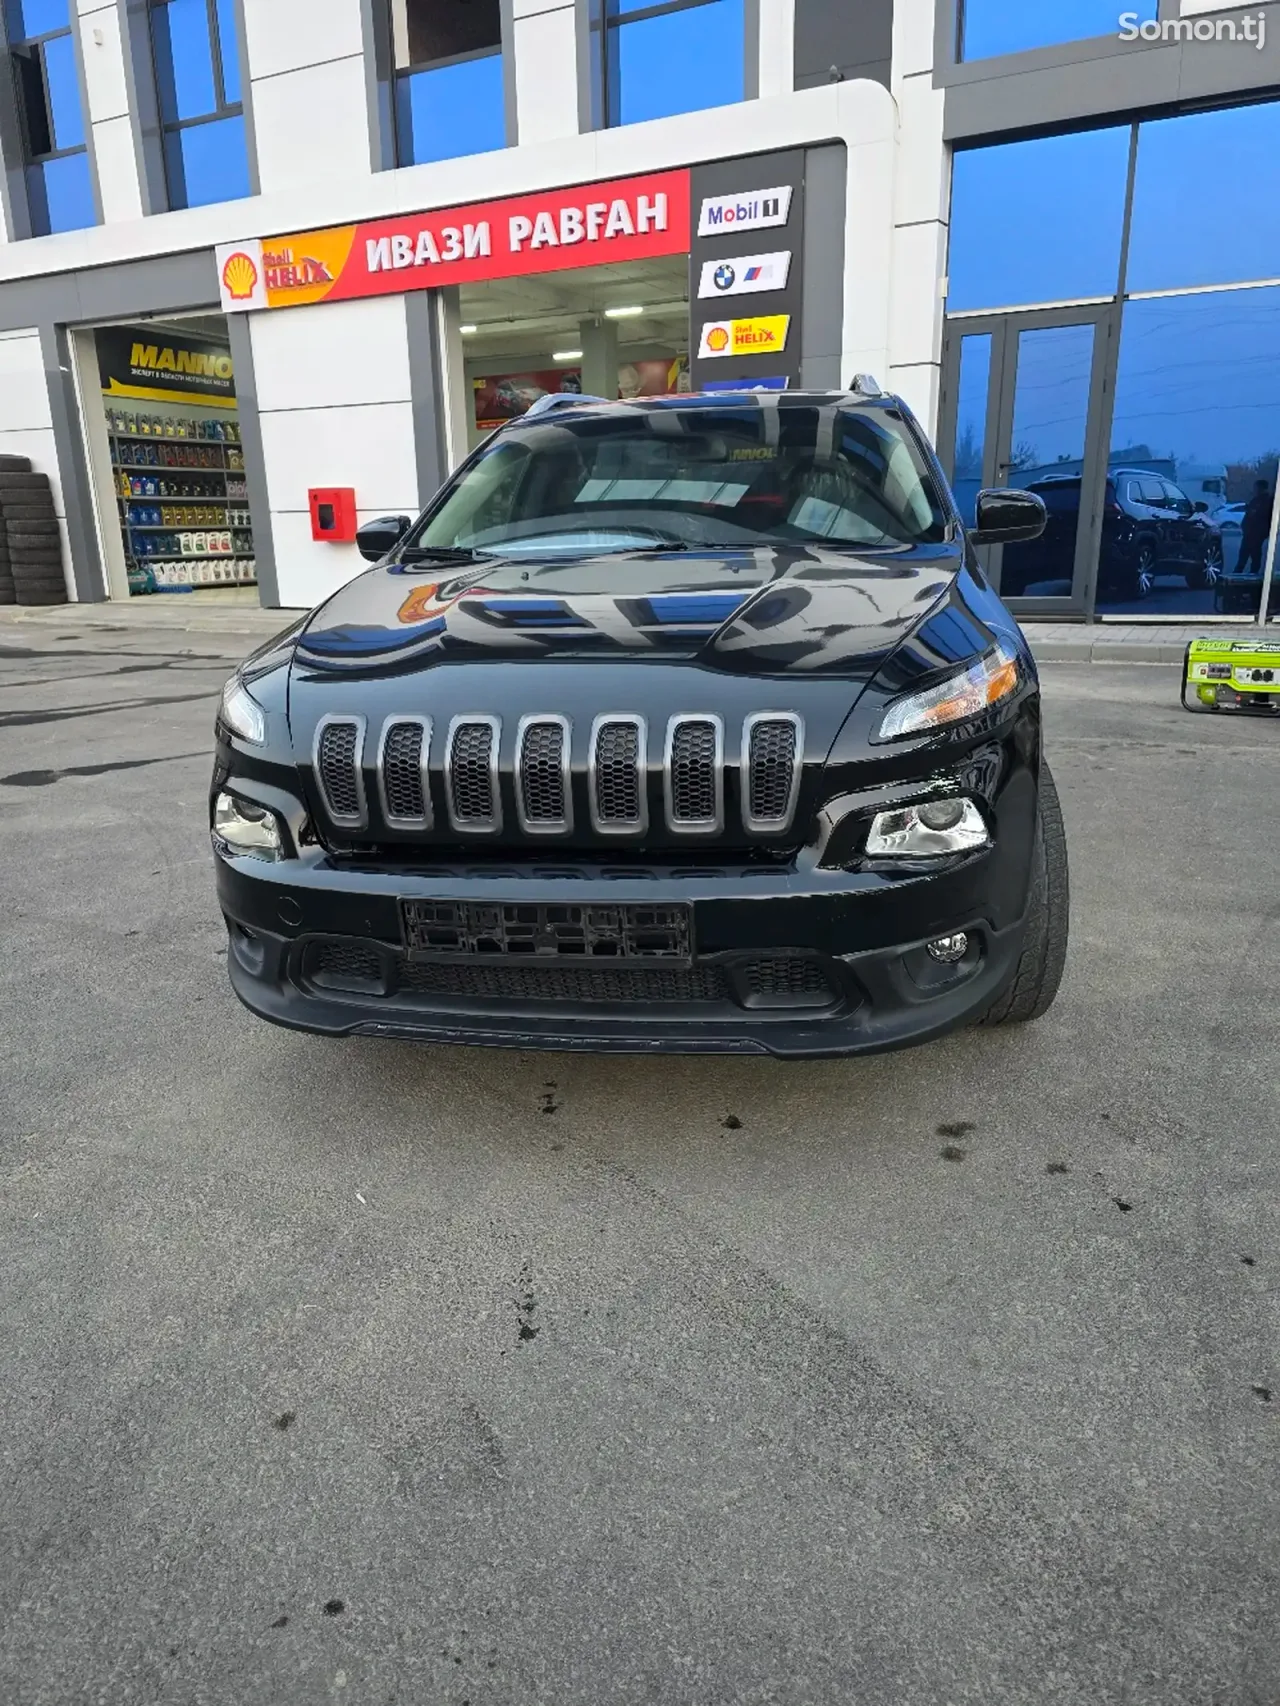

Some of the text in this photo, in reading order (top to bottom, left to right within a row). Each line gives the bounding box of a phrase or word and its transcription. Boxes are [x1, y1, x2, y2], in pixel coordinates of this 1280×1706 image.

[708, 198, 779, 225] Mobil 1
[262, 248, 292, 266] Shell
[366, 221, 491, 272] ИВАЗИ
[264, 256, 333, 289] HELIX
[735, 331, 775, 345] HELIX
